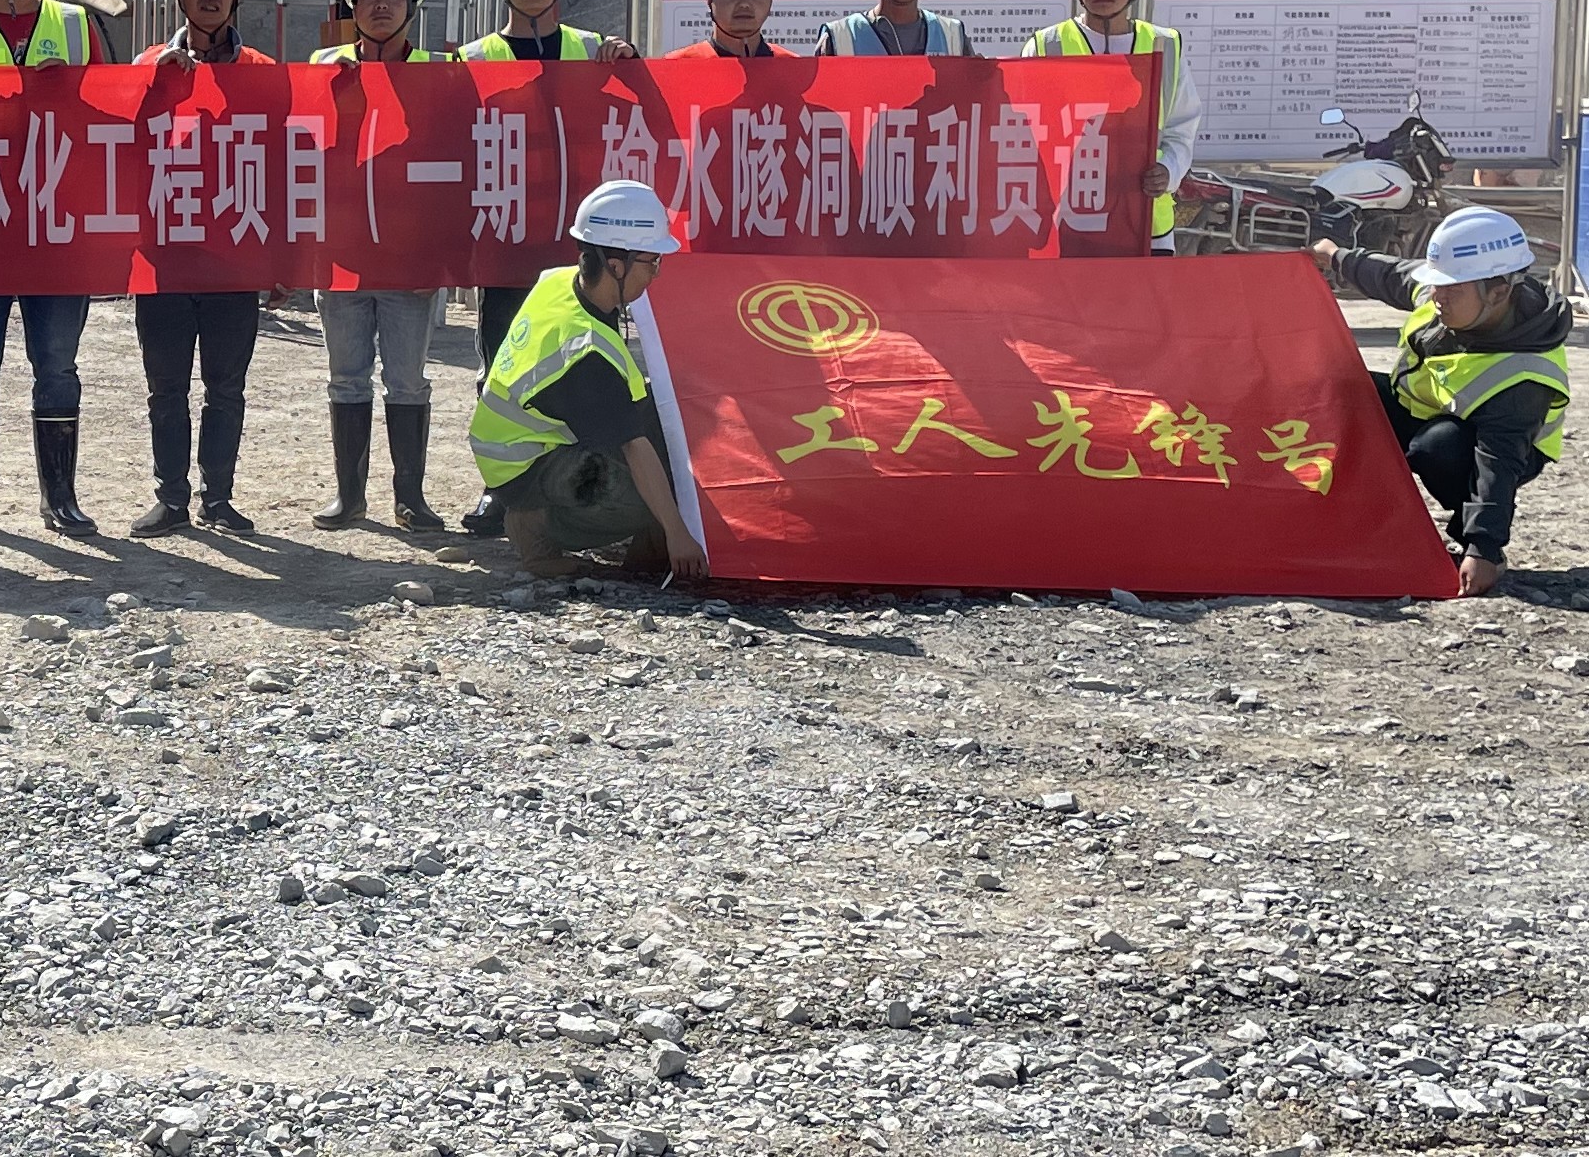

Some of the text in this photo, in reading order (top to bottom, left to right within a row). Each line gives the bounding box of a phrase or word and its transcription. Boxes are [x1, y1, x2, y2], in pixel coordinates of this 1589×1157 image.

[776, 390, 1337, 495] 工人先锋号
